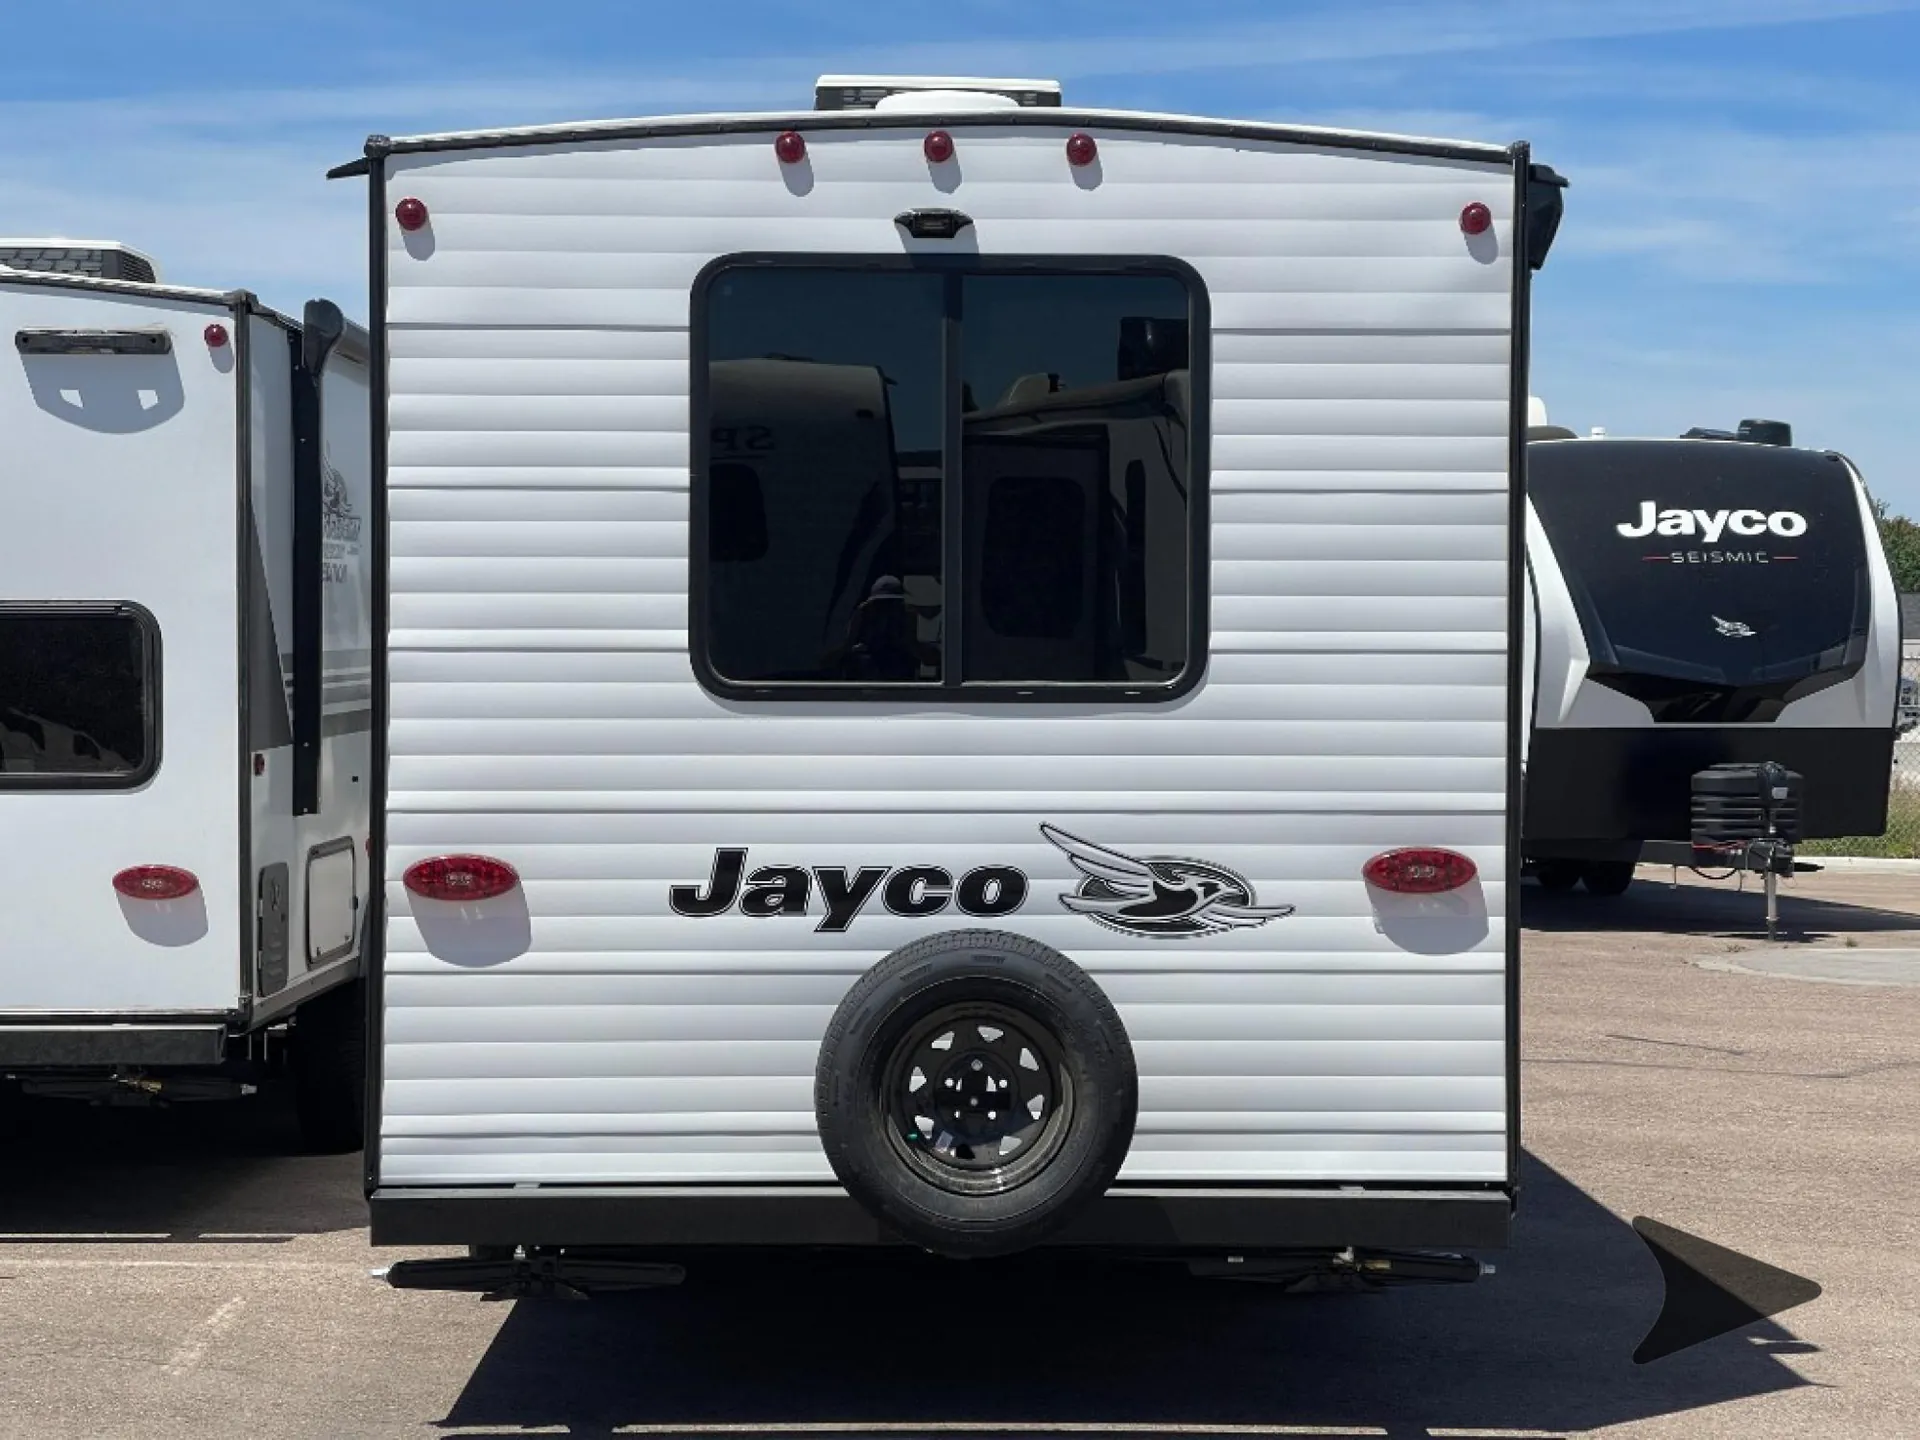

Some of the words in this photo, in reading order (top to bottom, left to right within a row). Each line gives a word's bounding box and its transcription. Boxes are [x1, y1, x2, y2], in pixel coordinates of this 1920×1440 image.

[1616, 500, 1808, 542] Jayco
[1671, 551, 1769, 563] SEISMIC
[669, 847, 1029, 932] Jayco
